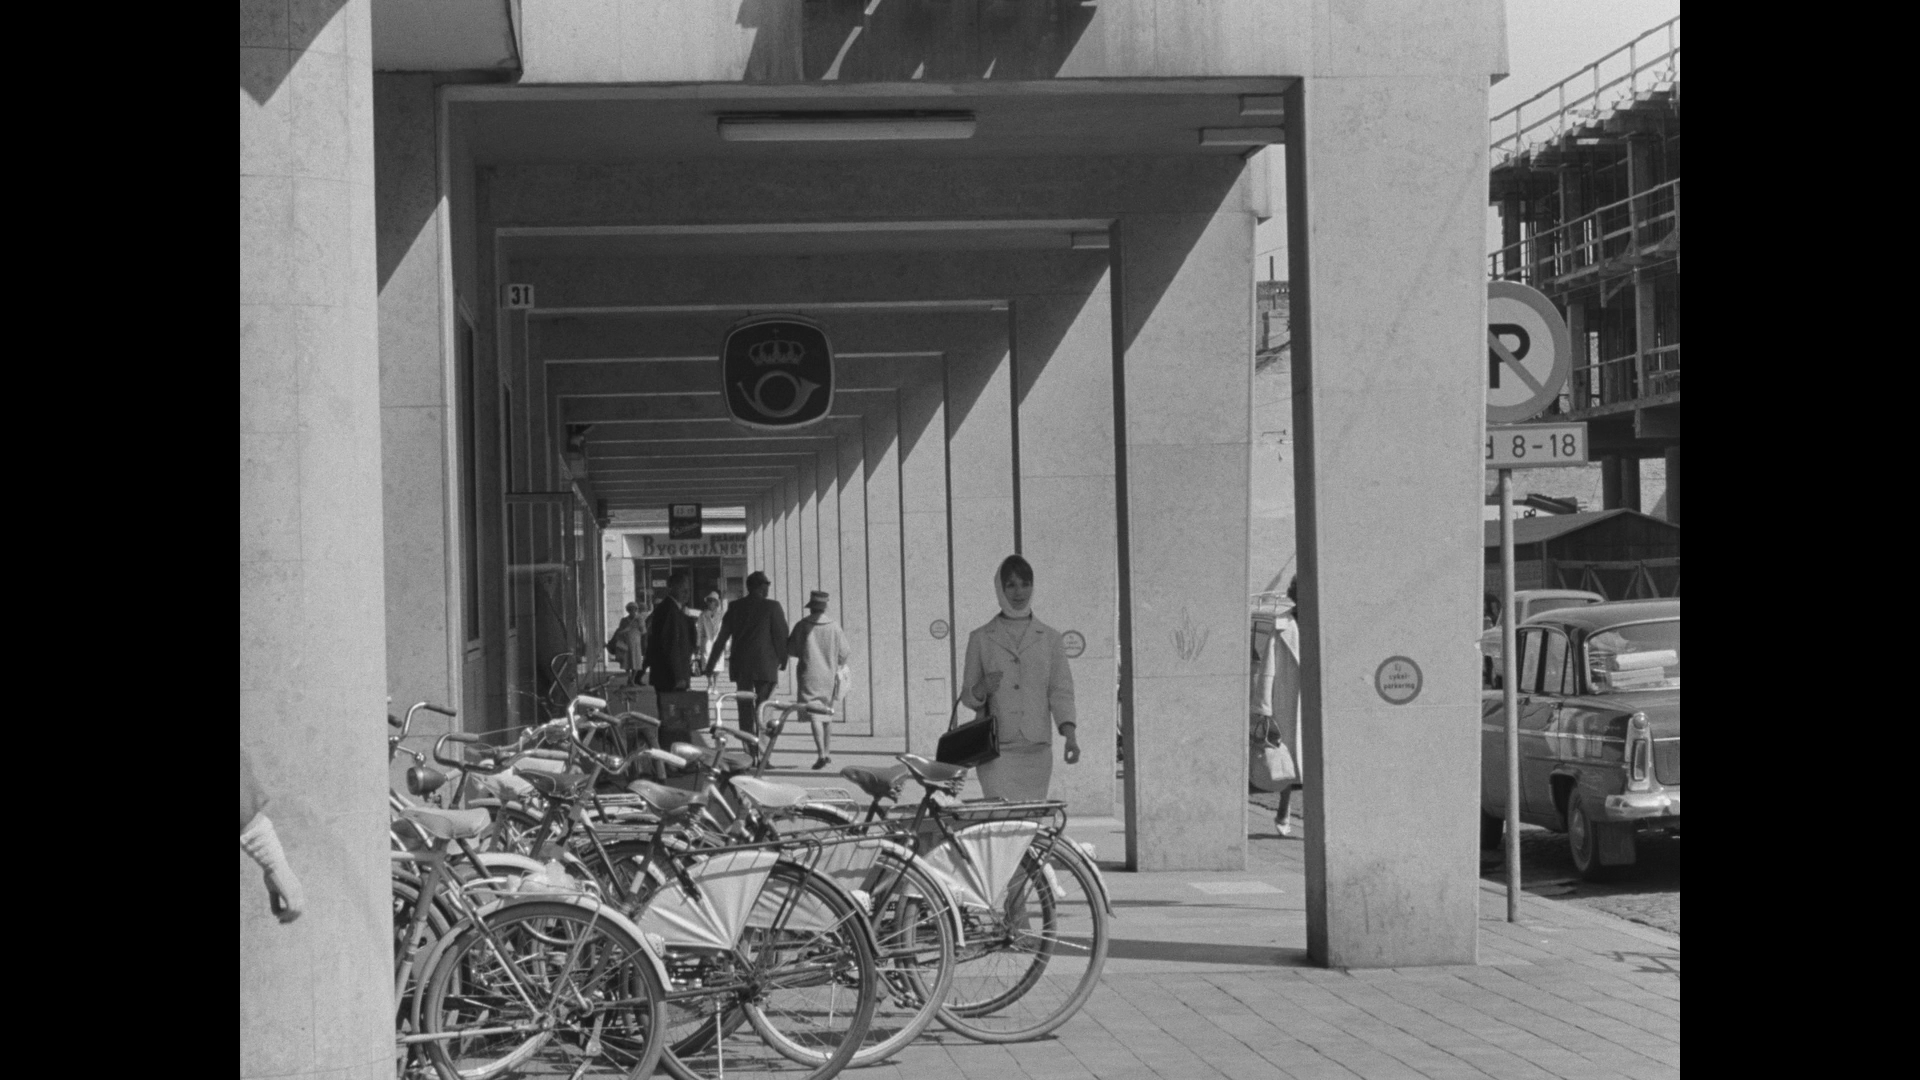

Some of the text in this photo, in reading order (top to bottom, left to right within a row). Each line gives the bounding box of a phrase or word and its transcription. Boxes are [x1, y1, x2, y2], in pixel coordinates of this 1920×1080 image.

[511, 285, 530, 305] 31
[1488, 323, 1531, 389] P
[1512, 433, 1576, 459] 8-18
